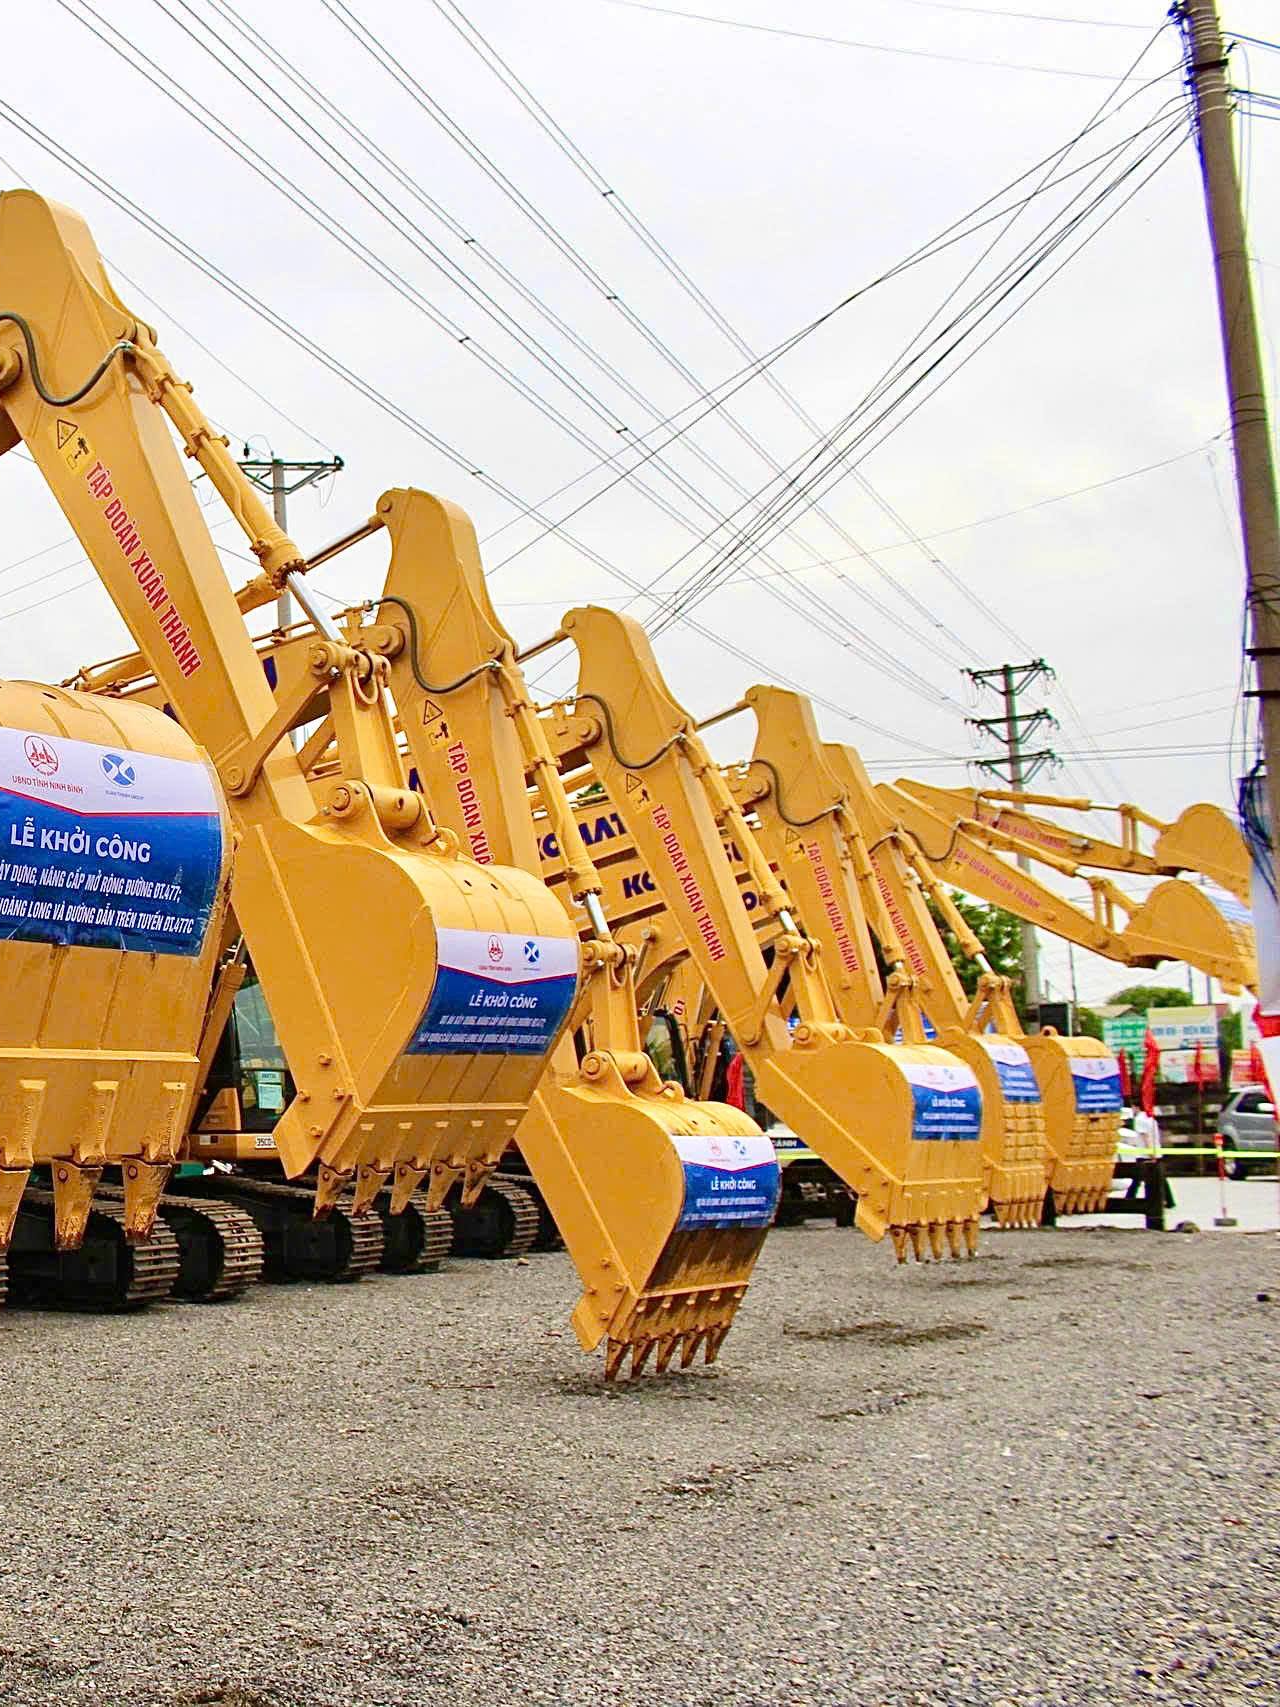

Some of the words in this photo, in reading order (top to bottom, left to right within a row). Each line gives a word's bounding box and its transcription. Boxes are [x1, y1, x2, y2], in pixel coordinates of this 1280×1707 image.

[86, 462, 114, 499] TẬP
[104, 498, 141, 556] ĐOÀN
[130, 551, 169, 611] XUÂN
[158, 605, 202, 678] THÀNH
[10, 817, 35, 847] LỄ
[40, 826, 91, 855] KHỞI
[96, 834, 151, 863] CÔNG
[470, 831, 495, 864] XUÂ
[27, 901, 53, 920] LONG
